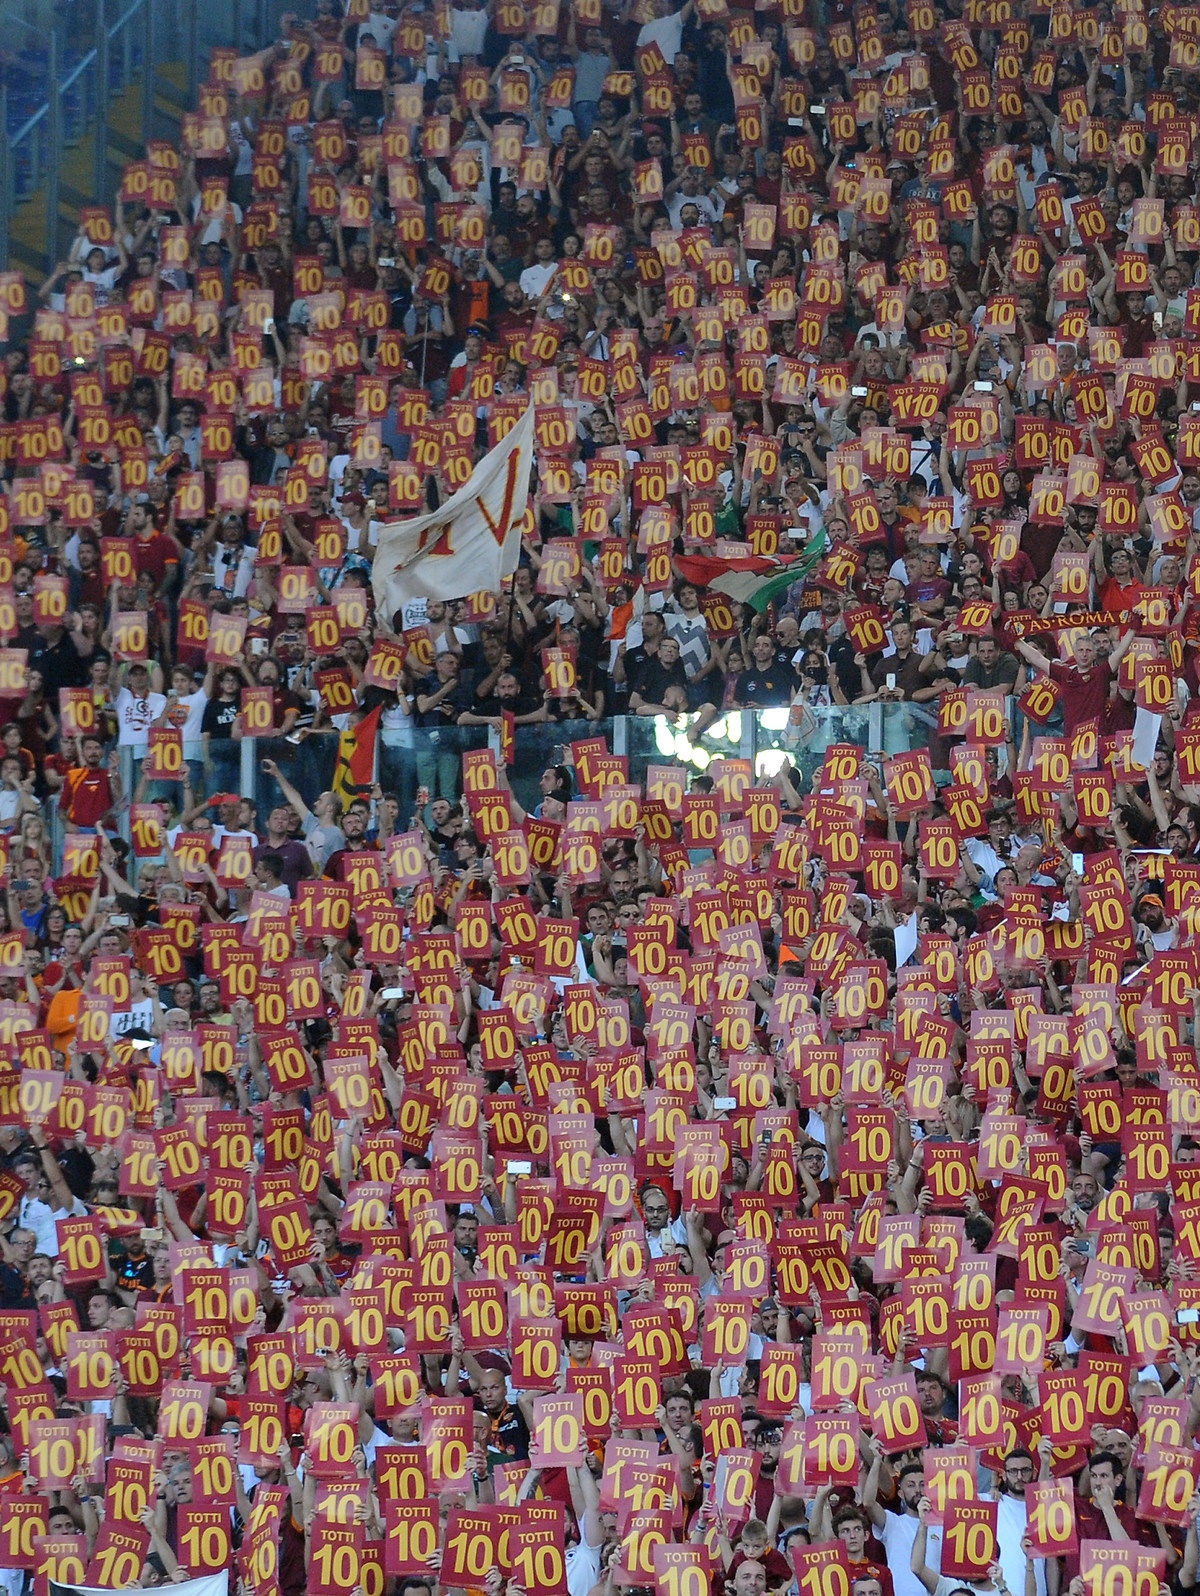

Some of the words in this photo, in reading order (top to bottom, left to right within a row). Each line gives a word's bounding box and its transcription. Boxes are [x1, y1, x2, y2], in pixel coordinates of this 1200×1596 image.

[896, 128, 920, 152] 10
[685, 145, 710, 167] 10
[862, 191, 889, 215] 10
[85, 218, 111, 240] 10
[1017, 239, 1039, 247] TOTTI
[1014, 248, 1039, 273] 10
[296, 267, 322, 291] 10
[532, 333, 557, 359] 10
[1023, 423, 1044, 431] TOTTI
[1020, 432, 1048, 458] 10
[1107, 487, 1129, 496] TOTTI
[1102, 497, 1130, 524] 10
[104, 550, 136, 579] 10
[547, 651, 571, 660] TOTTI
[545, 661, 575, 688] 10
[1143, 664, 1167, 673] TOTTI
[245, 691, 268, 700] TOTTI
[1139, 674, 1171, 703] 10
[244, 701, 271, 727] 10
[974, 698, 1000, 706] TOTTI
[970, 708, 1002, 737] 10
[154, 732, 179, 741] TOTTI
[151, 742, 182, 771] 10
[689, 799, 715, 809] TOTTI
[685, 810, 718, 839] 10
[869, 849, 894, 859] TOTTI
[866, 860, 898, 890] 10
[372, 911, 398, 921] TOTTI
[545, 923, 572, 933] TOTTI
[366, 922, 400, 953] 10
[634, 931, 660, 939] TOTTI
[539, 935, 575, 967] 10
[630, 942, 667, 974] 10
[203, 1029, 230, 1039] TOTTI
[203, 1040, 233, 1072] 10
[975, 1044, 1005, 1055] TOTTI
[971, 1056, 1010, 1090] 10
[217, 1123, 246, 1132] TOTTI
[272, 1114, 300, 1126] TOTTI
[856, 1114, 886, 1124] TOTTI
[212, 1134, 251, 1168] 10
[267, 1127, 304, 1161] 10
[852, 1127, 891, 1162] 10
[63, 1221, 94, 1234] TOTTI
[61, 1235, 101, 1270] 10
[466, 1286, 497, 1299] TOTTI
[910, 1282, 942, 1294] TOTTI
[463, 1300, 503, 1337] 10
[907, 1296, 949, 1335] 10
[956, 1318, 990, 1328] TOTTI
[768, 1350, 795, 1362] TOTTI
[952, 1331, 995, 1370] 10
[763, 1363, 797, 1402] 10
[249, 1402, 279, 1413] TOTTI
[243, 1415, 282, 1454] 10
[816, 1420, 851, 1432] TOTTI
[810, 1433, 855, 1472] 10
[187, 1512, 222, 1525] TOTTI
[955, 1507, 990, 1519] TOTTI
[181, 1527, 228, 1566] 10
[321, 1529, 356, 1542] TOTTI
[947, 1522, 994, 1565] 10
[314, 1544, 358, 1587] 10
